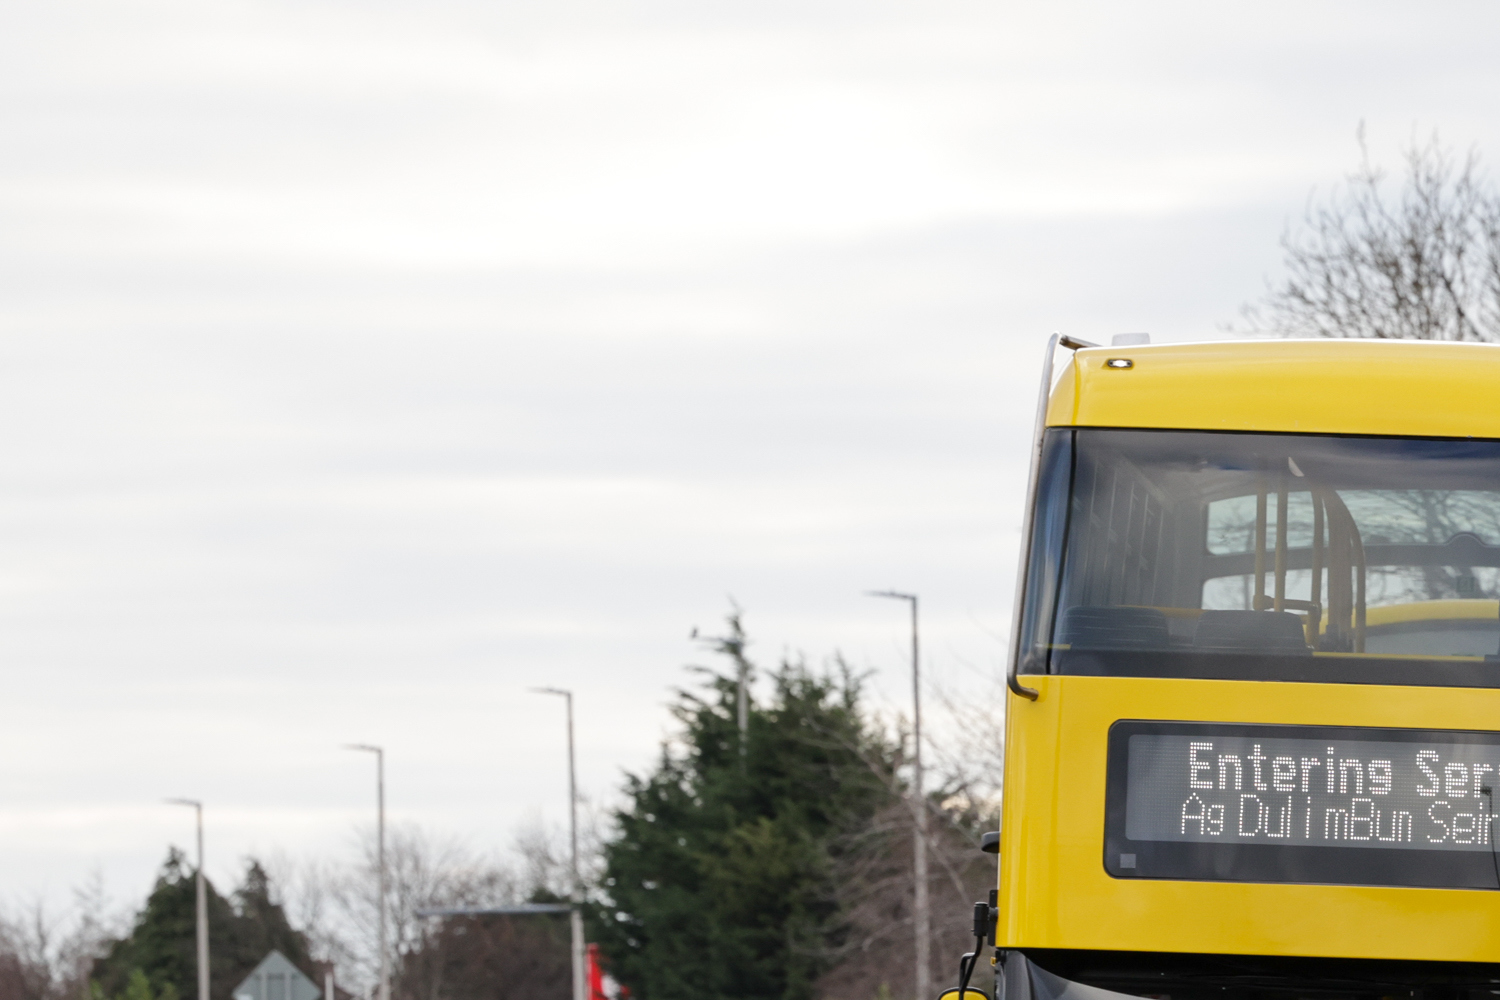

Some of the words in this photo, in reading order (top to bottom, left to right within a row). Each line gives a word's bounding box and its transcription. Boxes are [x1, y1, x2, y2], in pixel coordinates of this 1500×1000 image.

[1189, 741, 1392, 795] Entering
[1181, 792, 1225, 836] Ag
[1238, 793, 1292, 838] Dul
[1305, 796, 1312, 839] i
[1324, 797, 1413, 842] mBun
